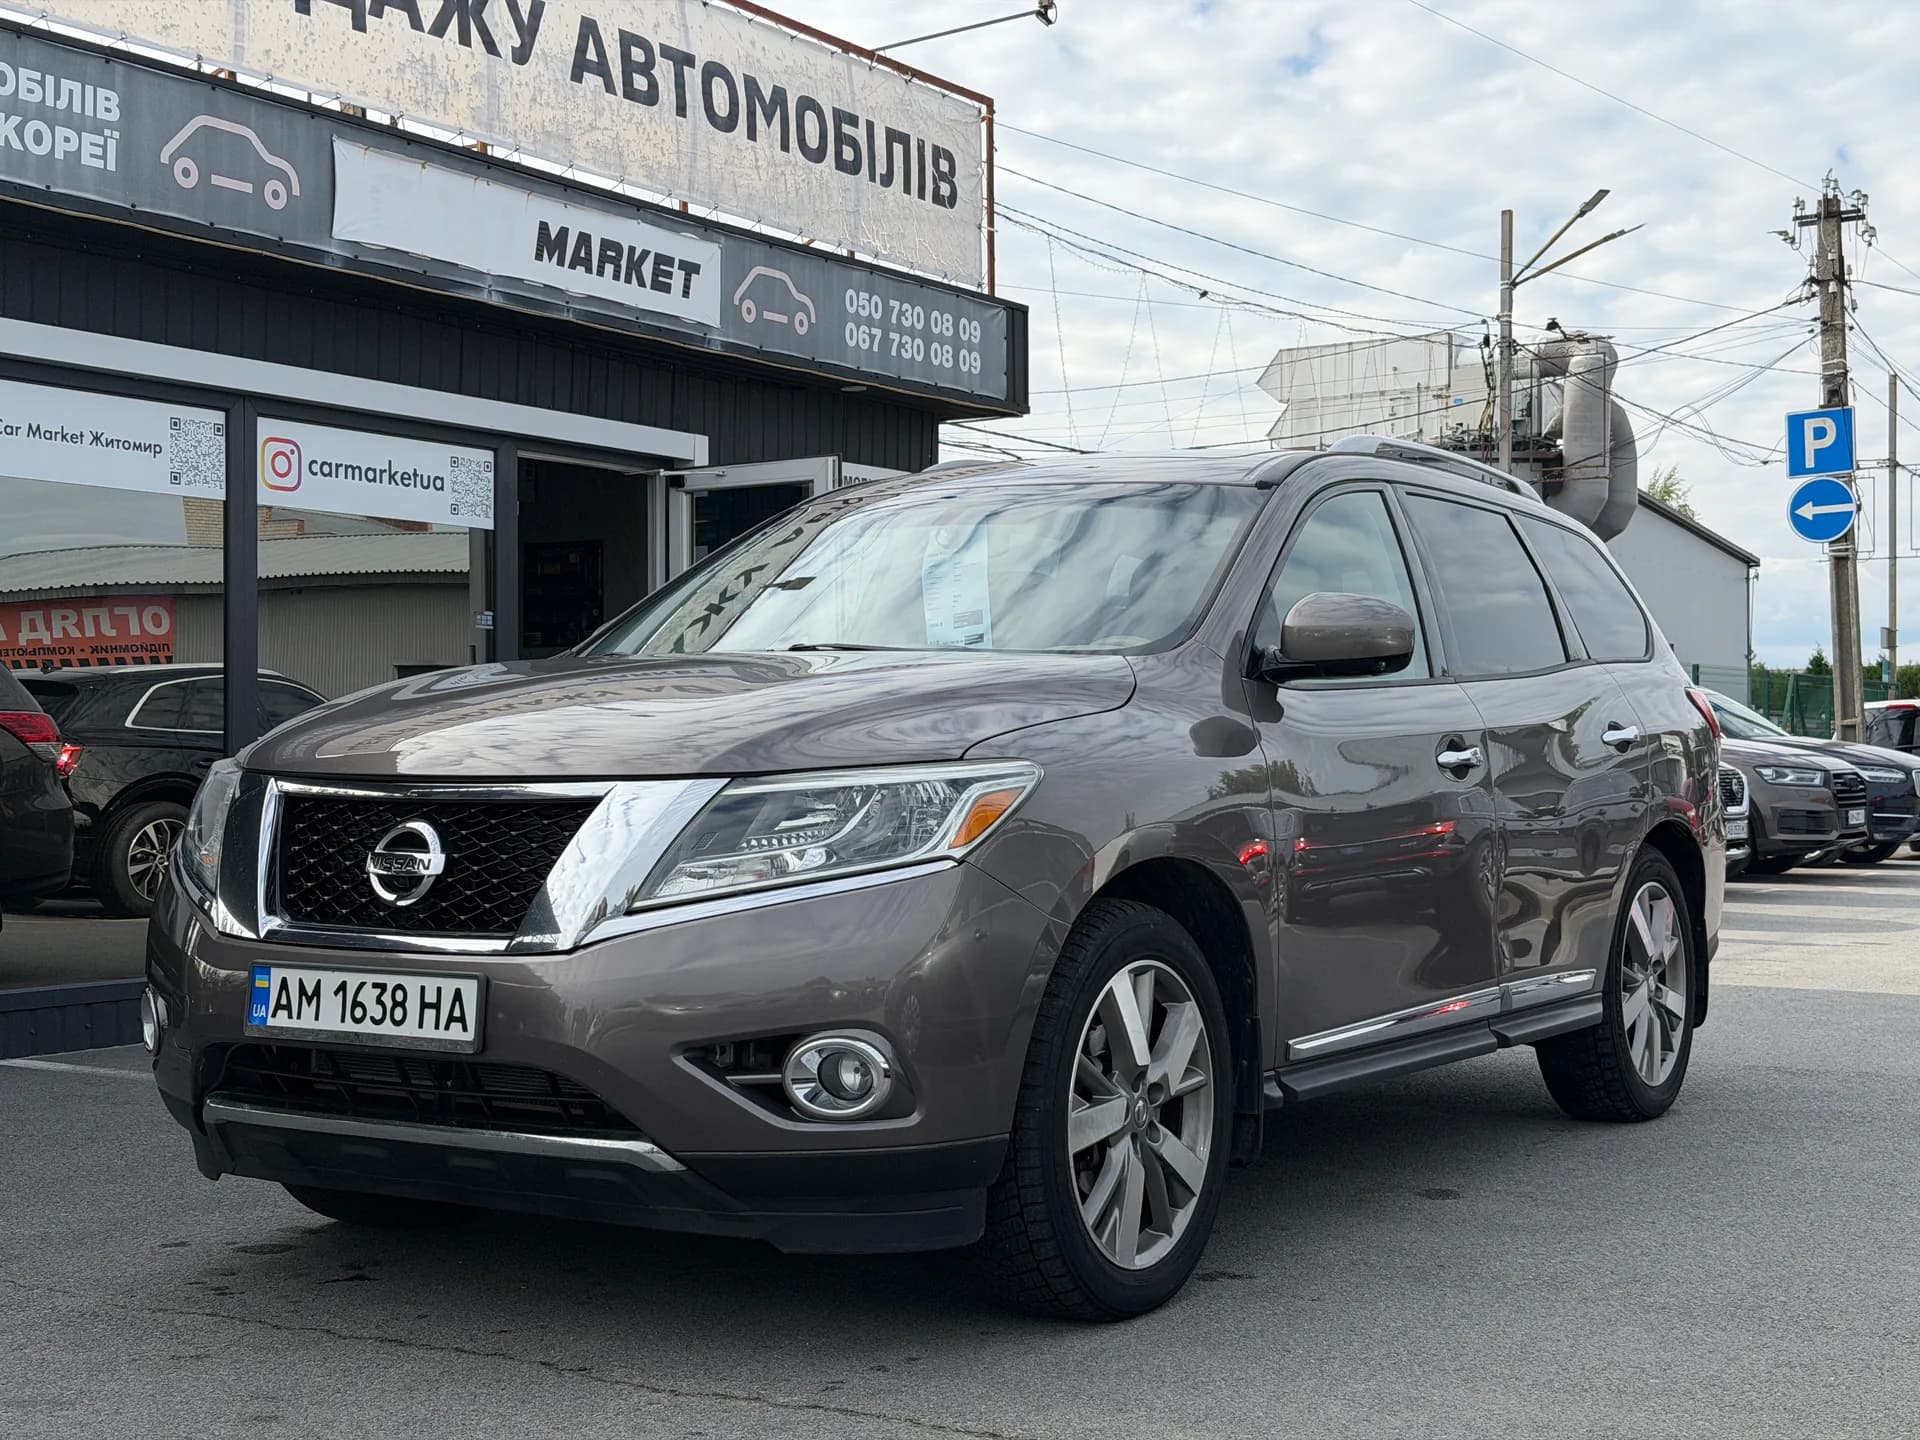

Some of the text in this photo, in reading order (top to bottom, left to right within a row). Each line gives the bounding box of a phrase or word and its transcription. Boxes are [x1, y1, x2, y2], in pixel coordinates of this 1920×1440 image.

[569, 15, 959, 211] АВТОМОБІЛІВ
[0, 112, 120, 172] КОРЕЇ
[534, 219, 702, 299] MARKET
[845, 289, 981, 344] 050 730 08 09
[845, 322, 981, 374] 067 730 08 09
[27, 422, 85, 445] Market
[89, 430, 163, 458] Житомир
[1804, 417, 1837, 469] P
[308, 458, 445, 492] carmarketua
[368, 855, 432, 874] NISSAN
[253, 1003, 267, 1019] UA
[270, 976, 468, 1033] AM 1638 HA
